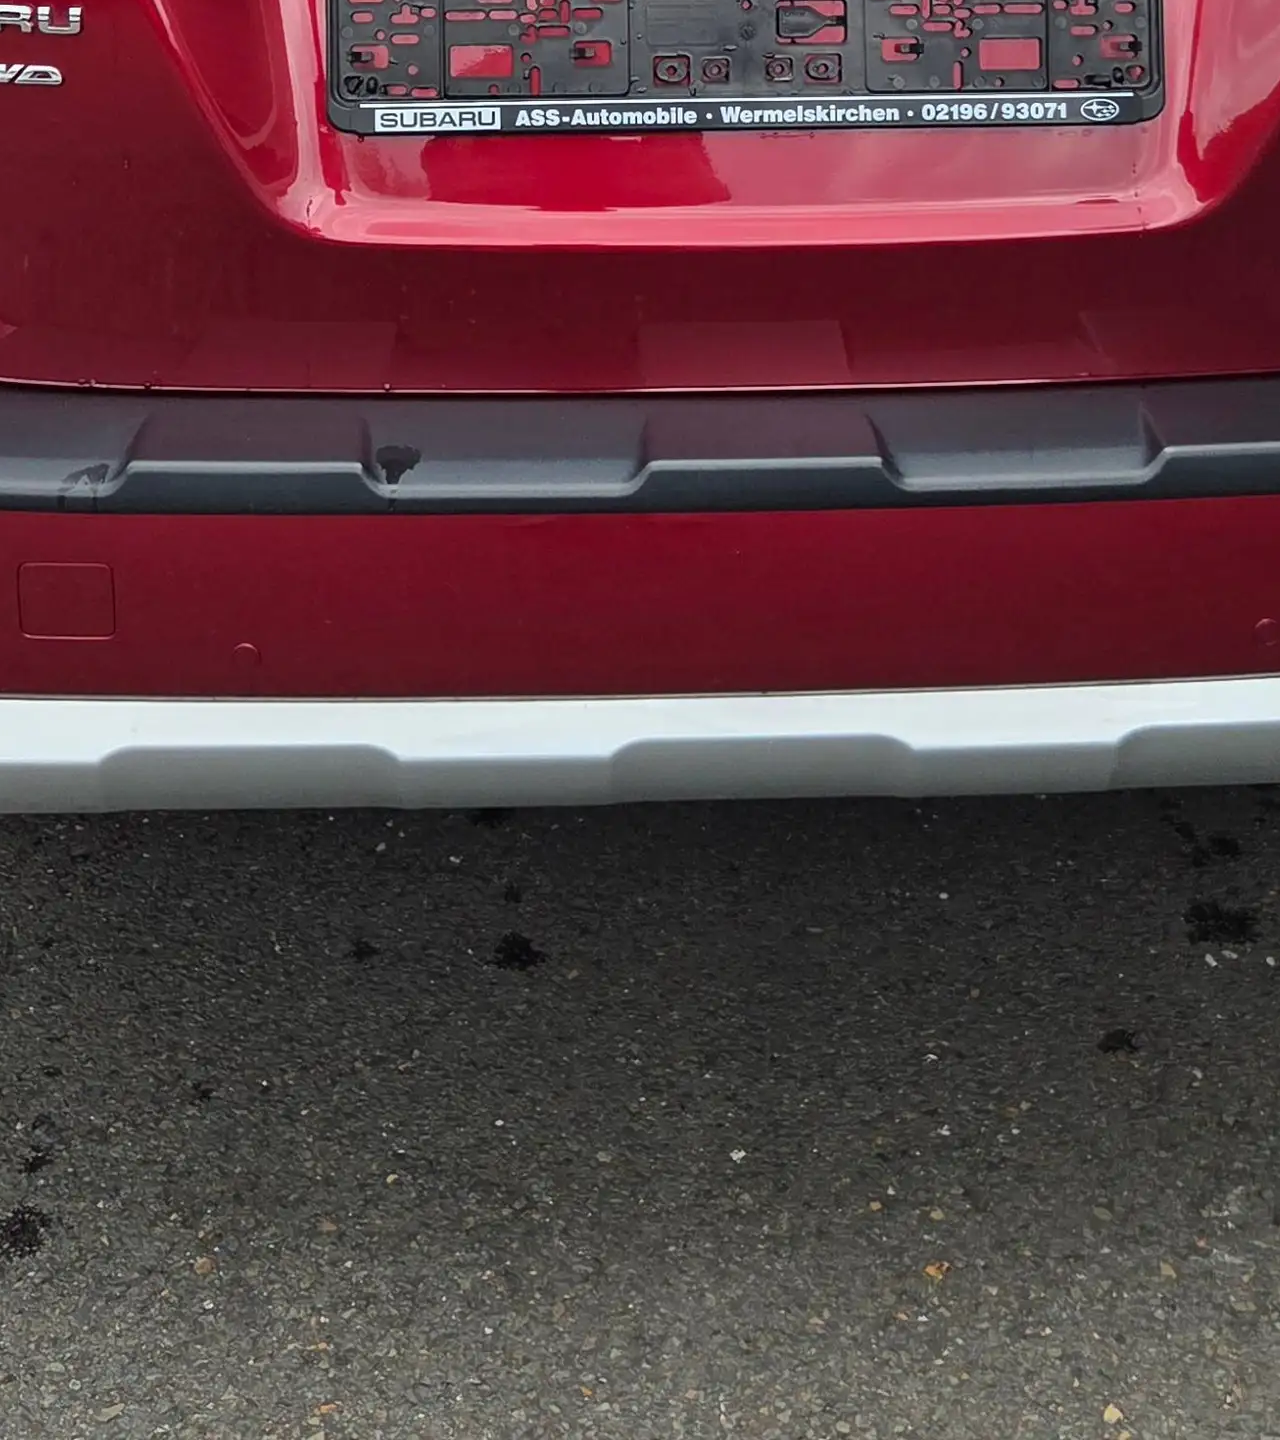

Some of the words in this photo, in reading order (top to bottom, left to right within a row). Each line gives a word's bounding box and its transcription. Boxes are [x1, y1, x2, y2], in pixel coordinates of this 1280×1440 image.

[379, 109, 496, 129] SUBARU
[515, 106, 698, 127] ASS-Automobile
[720, 104, 900, 124] Wermelskirchen
